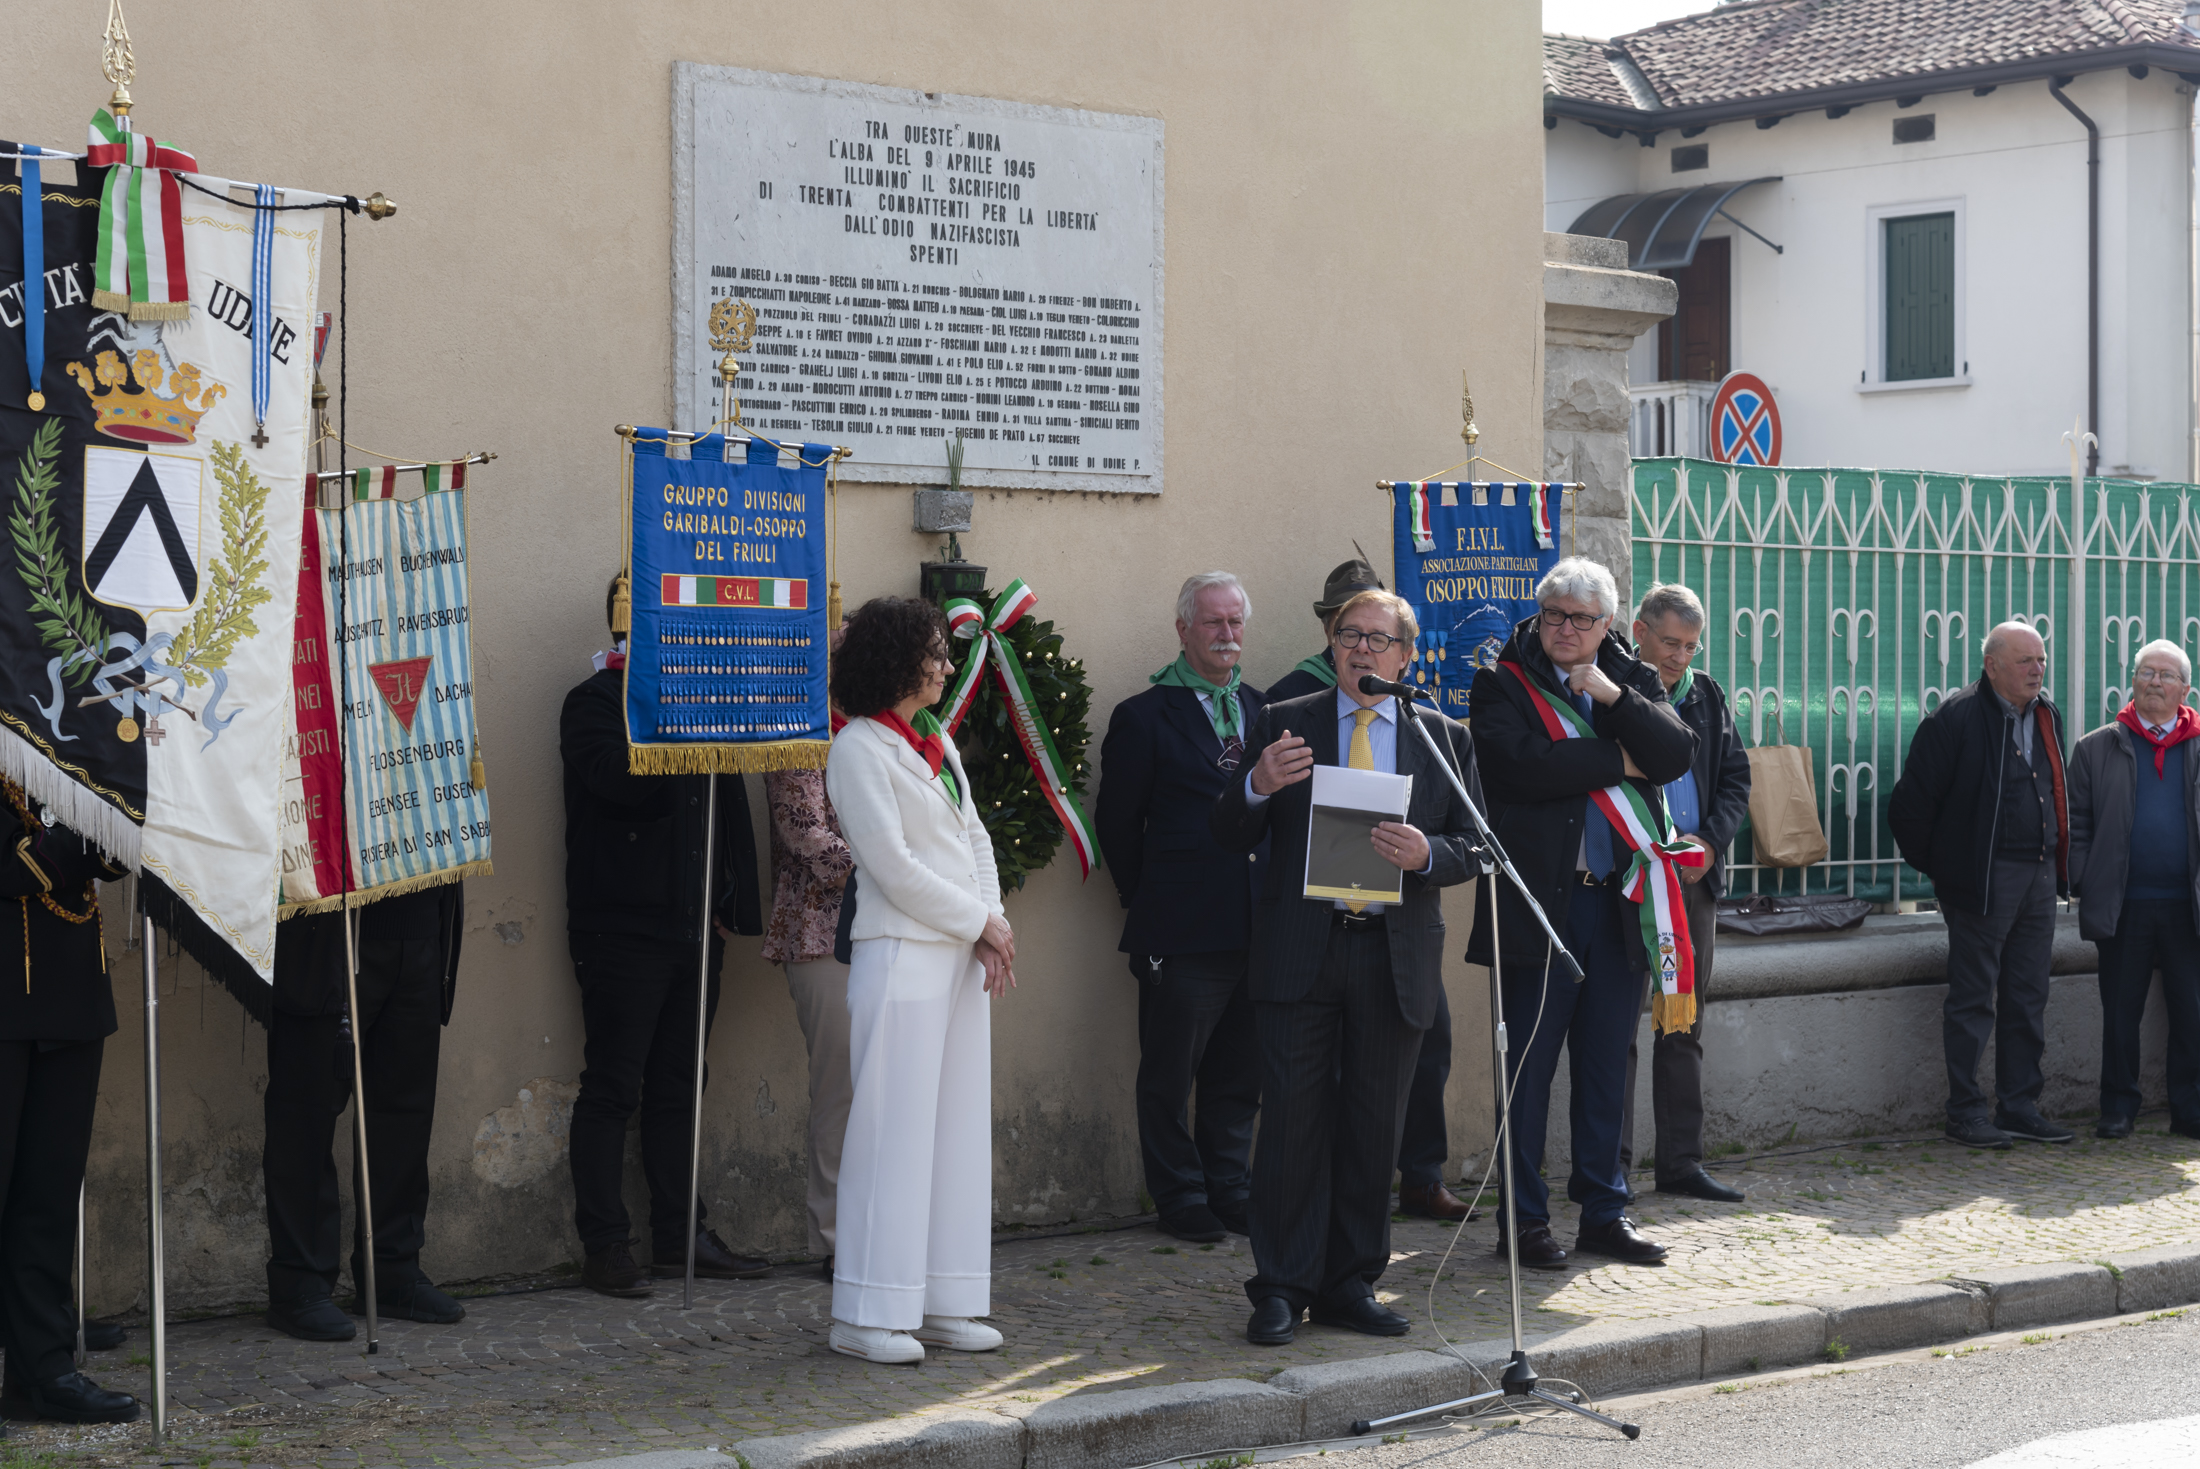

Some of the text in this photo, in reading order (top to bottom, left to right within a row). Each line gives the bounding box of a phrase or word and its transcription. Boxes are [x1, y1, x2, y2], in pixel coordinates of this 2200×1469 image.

[866, 120, 1001, 152] TRA QUESTE MURA
[887, 146, 911, 166] DEL
[925, 150, 933, 168] 9
[947, 153, 992, 175] APRILE
[1003, 159, 1035, 179] 1945
[922, 174, 935, 192] IL
[949, 177, 1020, 201] SACRIFICIO
[759, 181, 772, 200] DI
[799, 185, 852, 208] TRENTA
[878, 193, 969, 219] COMBATTENTI
[983, 203, 1006, 223] PER
[1019, 207, 1034, 225] LA
[931, 222, 1020, 248] NAZIFASCISTA
[910, 244, 958, 266] SPENTI
[711, 265, 736, 278] ADAMO
[740, 267, 770, 281] ANGELO
[829, 275, 856, 288] BECCIA
[861, 278, 874, 290] GIO
[877, 279, 898, 292] BATTA
[959, 286, 999, 300] BOLOGNATO
[1003, 289, 1024, 302] MARIO
[1049, 295, 1074, 306] FIRENZE
[1100, 298, 1131, 311] UMBERTO
[729, 285, 785, 300] ZOMPICCHIATTI
[789, 290, 831, 304] NAPOLEONE
[913, 300, 938, 312] MATTEO
[1009, 308, 1026, 319] LUIGI
[1046, 312, 1065, 322] TEGLIO
[1068, 314, 1089, 324] VENETO
[764, 308, 797, 320] POZZUOLO
[802, 311, 813, 321] DEL
[818, 313, 840, 323] FRIULI
[852, 313, 895, 327] CORADAZZI
[899, 317, 919, 329] LUIGI
[948, 322, 983, 333] SOCCHIEVE
[992, 324, 1005, 335] DEL
[1009, 325, 1040, 338] VECCHIO
[1044, 328, 1085, 341] FRANCESCO
[816, 329, 842, 341] FAVRET
[847, 331, 872, 343] OVIDIO
[896, 336, 921, 347] AZZANO
[940, 338, 978, 351] FOSCHIANI
[984, 341, 1006, 353] MARIO
[1040, 345, 1070, 357] MODOTTI
[1075, 347, 1096, 359] MARIO
[1121, 352, 1138, 362] UDINE
[756, 342, 797, 356] SALVATORE
[900, 352, 932, 365] GIOVANNI
[964, 357, 983, 368] POLO
[987, 358, 1002, 370] ELIO
[1049, 364, 1054, 374] DI
[1058, 365, 1076, 375] SOTTO
[1116, 367, 1139, 379] ALBINO
[837, 366, 857, 378] LUIGI
[883, 371, 908, 381] GORIZIA
[918, 371, 942, 384] LIVONI
[946, 373, 962, 385] ELIO
[995, 376, 1026, 389] POTOCCO
[1031, 379, 1061, 391] ARDUINO
[813, 382, 854, 395] MOROCUTTI
[859, 385, 891, 398] ANTONIO
[915, 391, 937, 400] TREPPO
[1004, 394, 1034, 406] LEANDRO
[1124, 402, 1139, 413] GINO
[792, 399, 835, 413] PASCUTTINI
[840, 402, 865, 414] ENRICO
[977, 410, 998, 422] ENNIO
[1023, 415, 1041, 425] VILLA
[1116, 418, 1139, 430] BENITO
[759, 418, 767, 428] AL
[811, 419, 843, 431] TESOLIN
[847, 421, 872, 433] GIULIO
[896, 426, 916, 435] FIUME
[920, 427, 944, 437] VENETO
[989, 428, 998, 439] DE
[1002, 429, 1024, 441] PRATO
[1048, 434, 1080, 444] SOCCHIEVE
[1048, 455, 1078, 466] COMUNE
[1087, 457, 1094, 467] DI
[1103, 457, 1125, 469] UDINE
[663, 484, 805, 512] GRUPPO DIVISIONI
[663, 511, 806, 538] GARIBALDI-OSOPPO
[695, 541, 776, 563] DEL FRIULI
[1456, 527, 1505, 551] F.I.V.L.
[329, 558, 383, 582] MAUTHAUSEN
[401, 547, 464, 573] BUCHENWALD
[1421, 556, 1539, 574] ASSOCIAZIONE PARTIGIANI
[724, 584, 754, 602] C.V.L.
[1425, 576, 1535, 604] OSOPPO FRIULI
[334, 619, 385, 644] AUSCHWITZ
[297, 683, 322, 711] NEI
[435, 682, 473, 704] DACHA
[286, 728, 330, 761] AZISTI
[370, 739, 464, 772] FLOSSENBURG
[369, 781, 476, 818] EBENSEE GUSEN
[361, 841, 399, 866] RISIERA
[403, 836, 418, 853] DI
[425, 829, 452, 848] SAN
